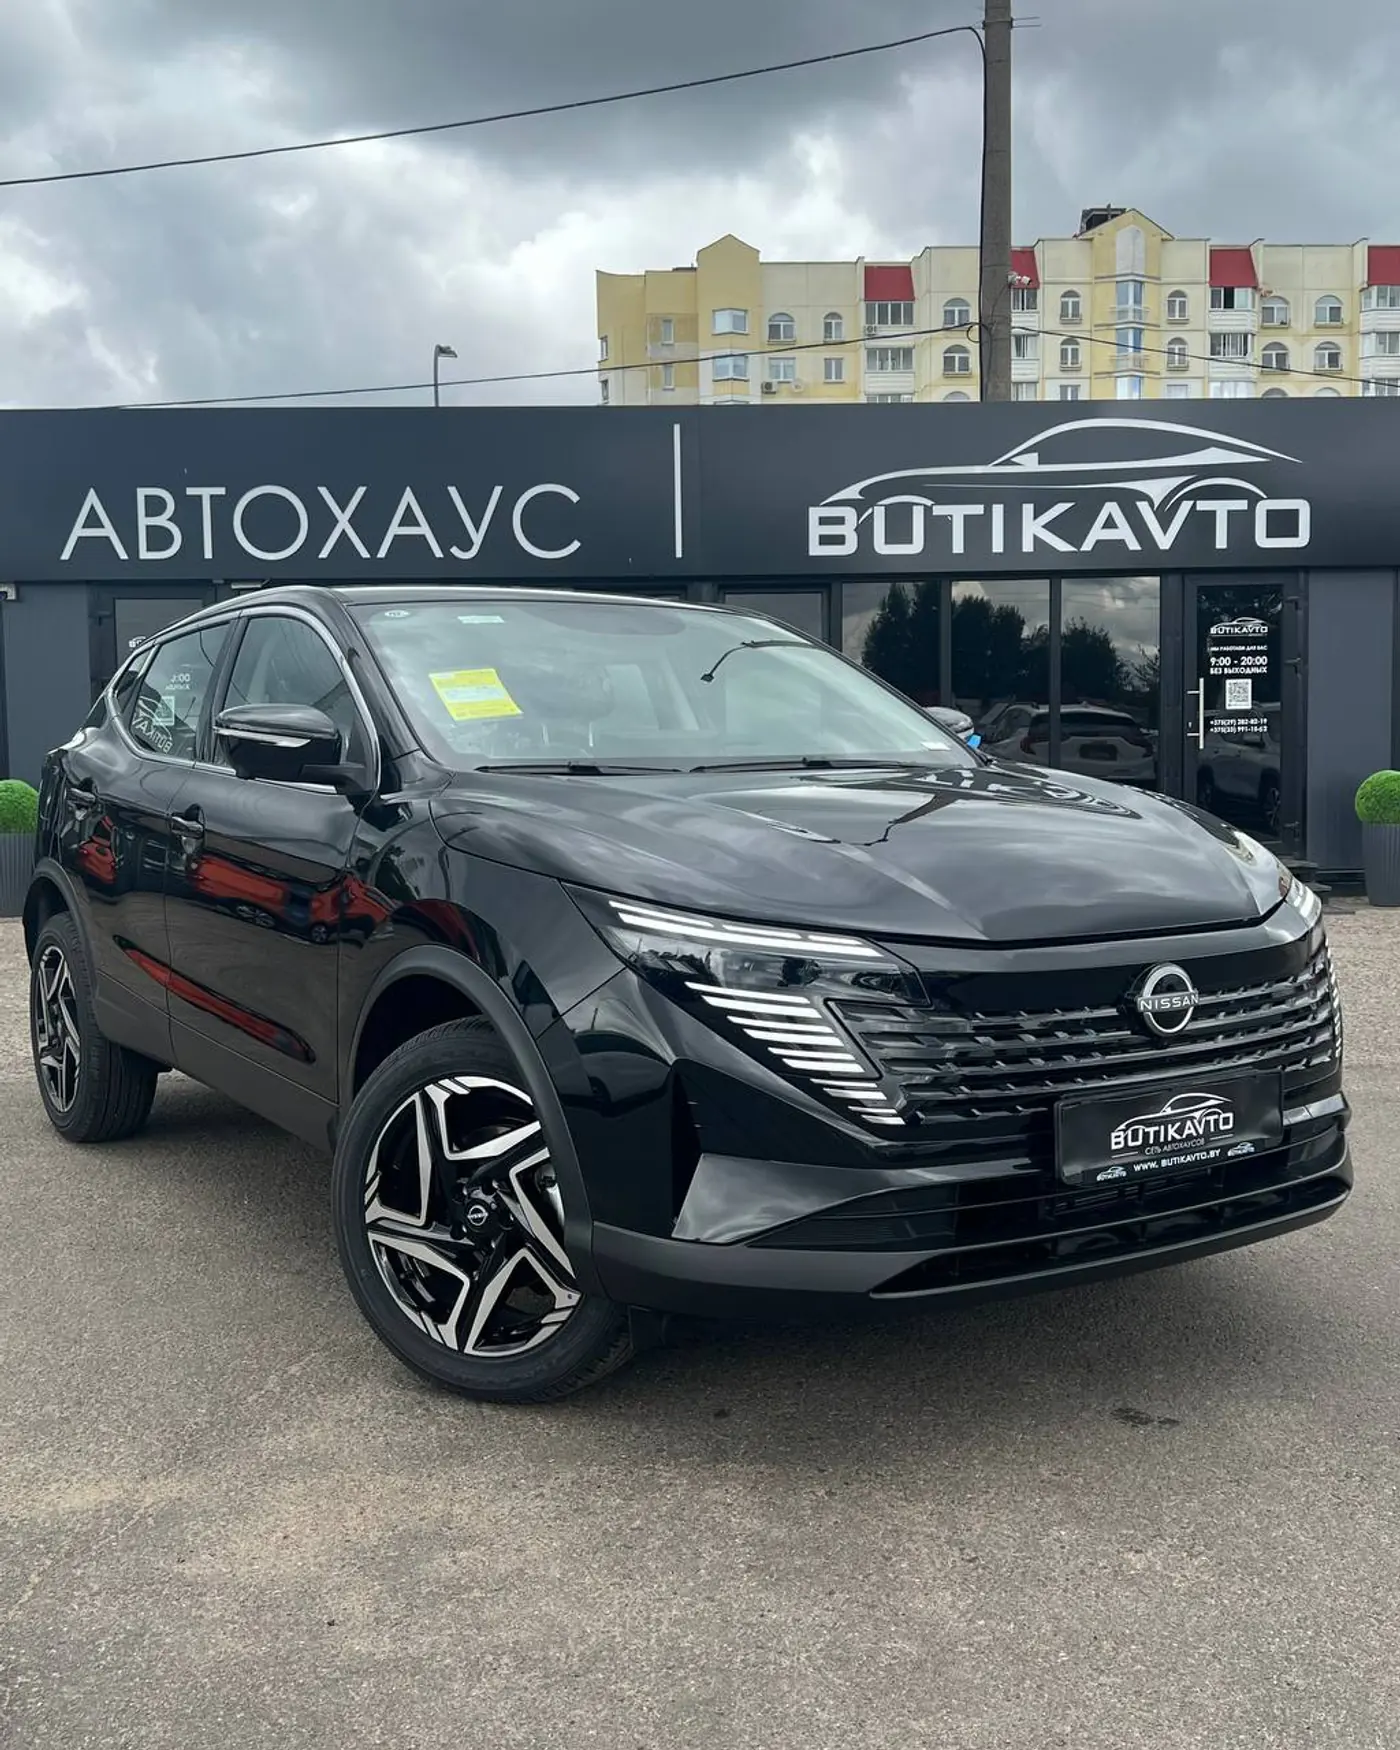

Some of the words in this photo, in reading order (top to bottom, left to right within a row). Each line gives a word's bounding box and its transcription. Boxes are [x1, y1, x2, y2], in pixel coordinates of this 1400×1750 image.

[60, 484, 582, 560] АВТОХАУС
[808, 497, 1311, 557] BUTIKAVTO
[1210, 626, 1268, 634] BUTIKAVTO
[1210, 656, 1231, 666] 9:00
[1240, 655, 1268, 666] 20:00
[1224, 666, 1268, 674] ВЫХОДНЫХ
[1140, 993, 1199, 1011] NISSAN
[1111, 1112, 1234, 1150] BUTIKAVTO
[1161, 1149, 1221, 1167] BUTIKAVTO.BY
